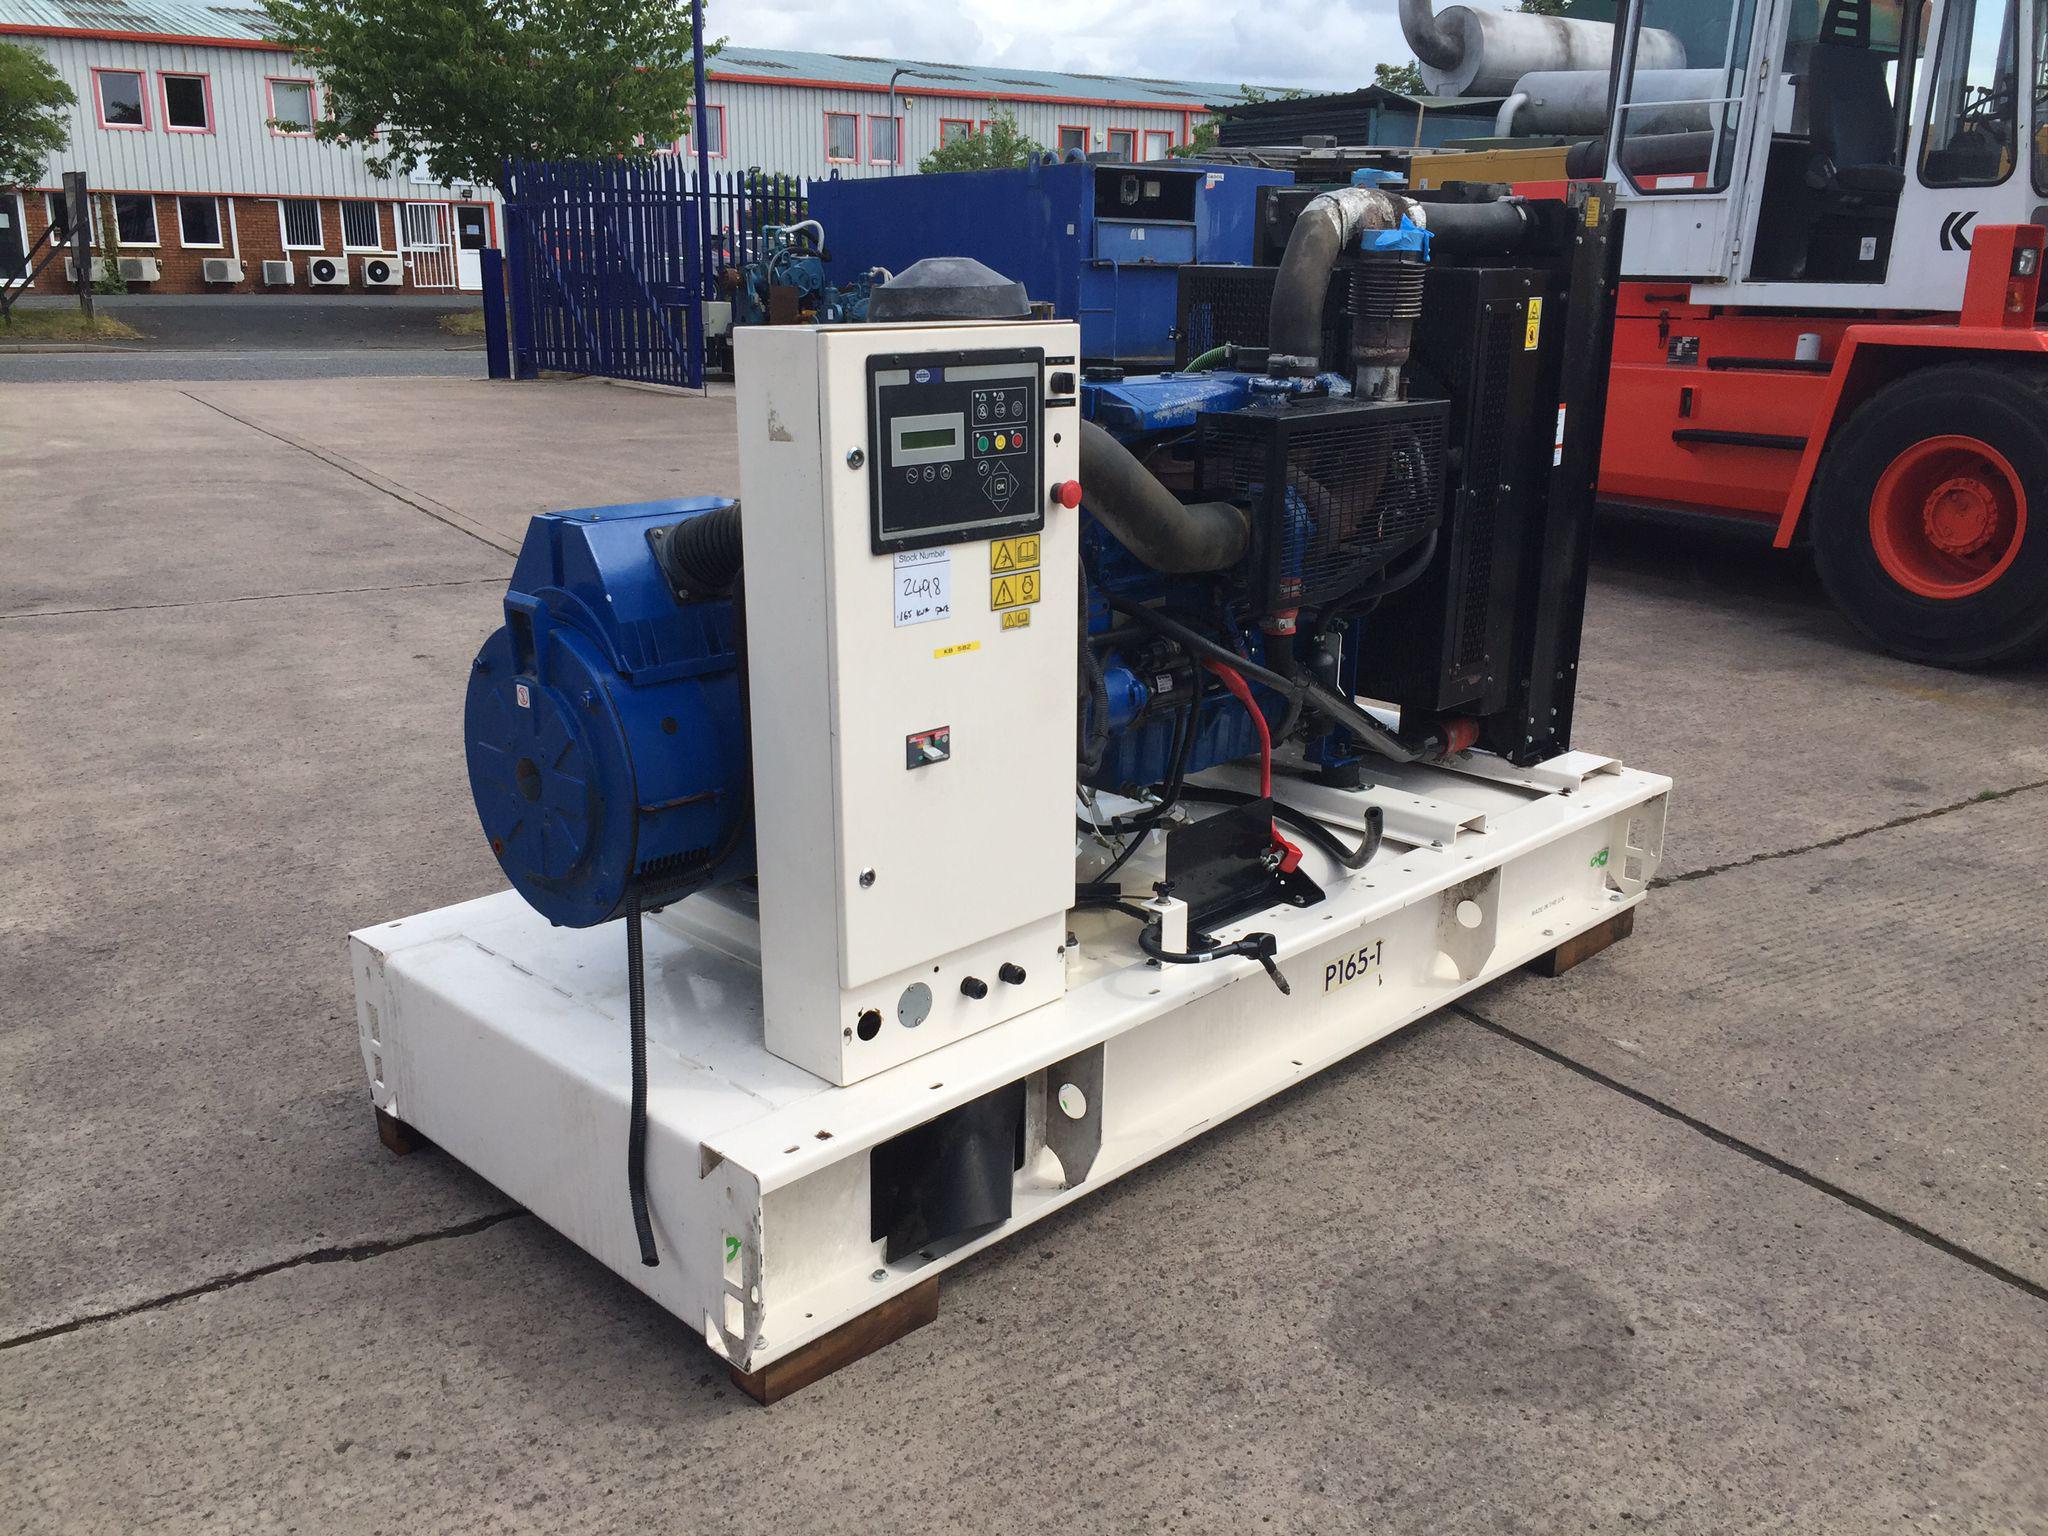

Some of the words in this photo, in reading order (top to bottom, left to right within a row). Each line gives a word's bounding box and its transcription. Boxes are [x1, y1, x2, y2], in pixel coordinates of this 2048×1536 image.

[996, 483, 1006, 491] OK
[899, 553, 918, 563] Stock
[920, 550, 946, 560] Number
[903, 577, 941, 598] 2498
[900, 609, 912, 621] 165
